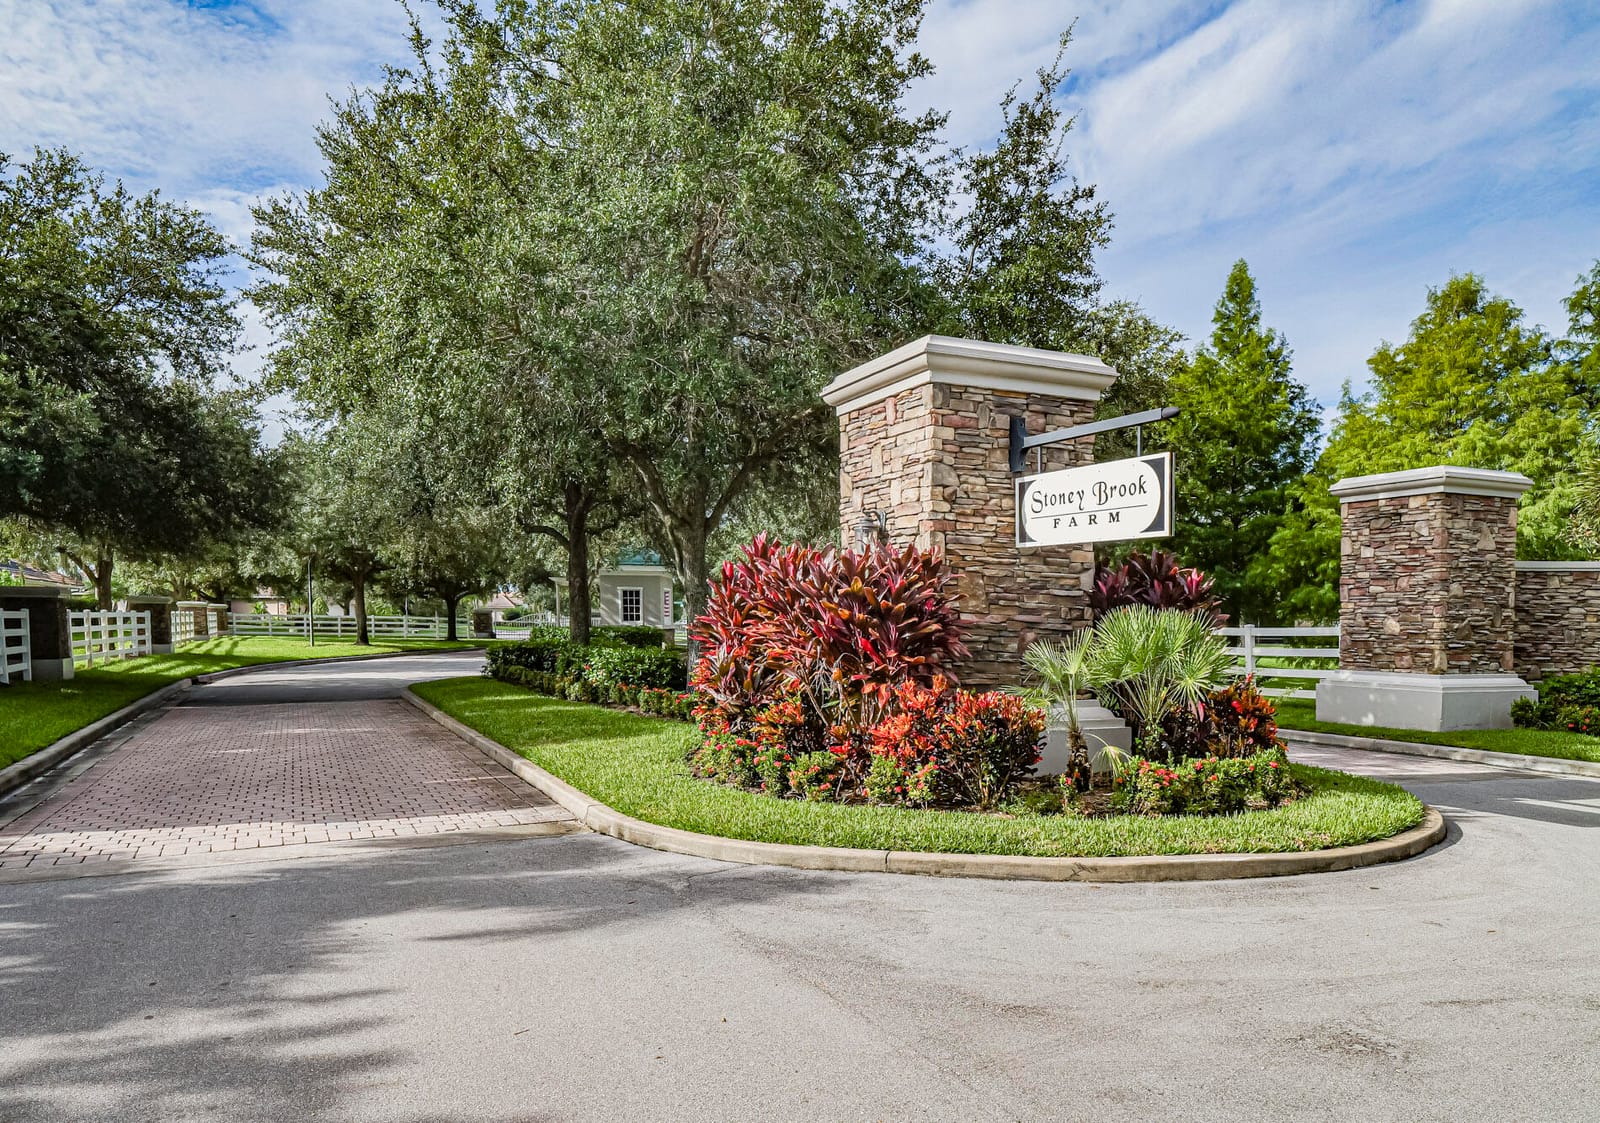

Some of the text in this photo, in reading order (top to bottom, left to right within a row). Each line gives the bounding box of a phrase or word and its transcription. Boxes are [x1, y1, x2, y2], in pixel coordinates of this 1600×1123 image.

[1031, 474, 1147, 514] Stoney Brook
[1053, 511, 1121, 529] FARM
